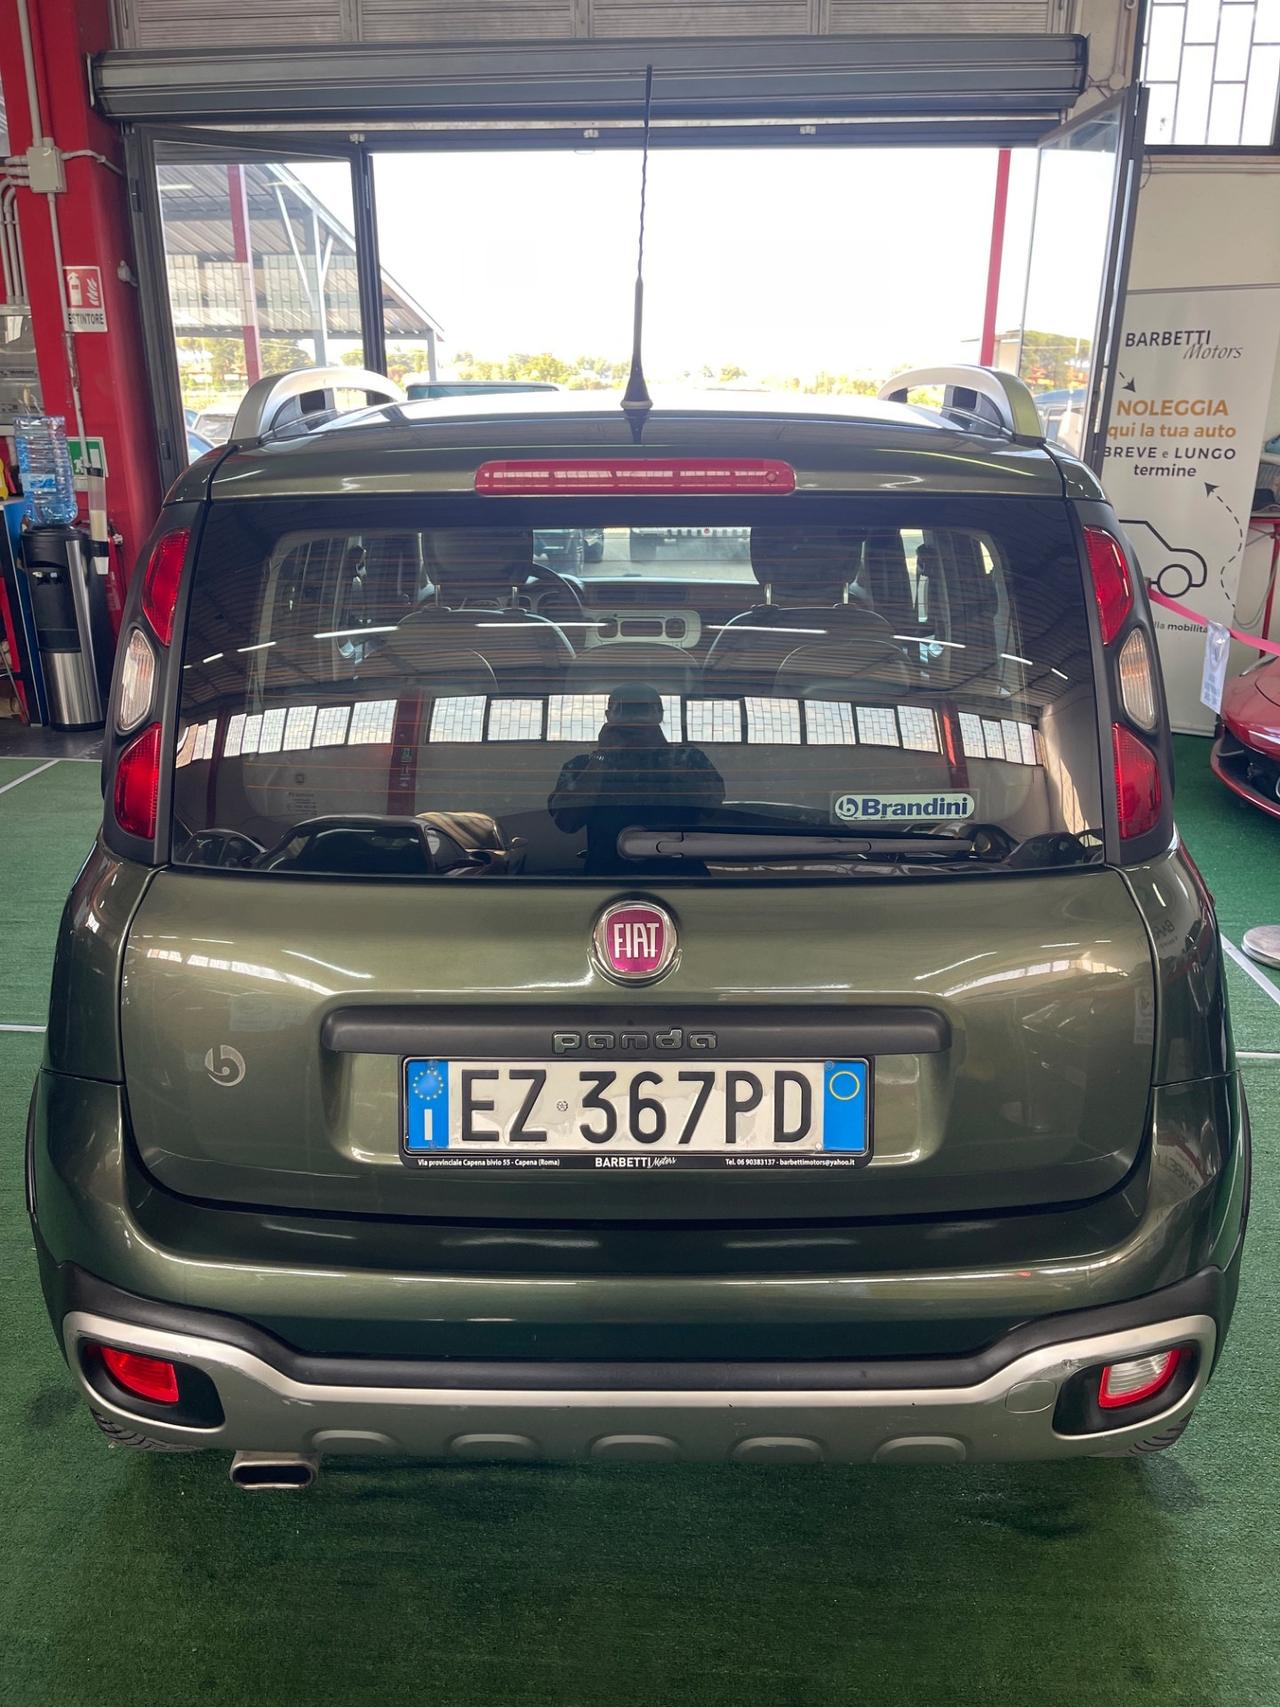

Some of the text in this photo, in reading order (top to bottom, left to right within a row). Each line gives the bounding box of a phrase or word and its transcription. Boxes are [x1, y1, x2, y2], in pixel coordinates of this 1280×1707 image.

[1125, 330, 1211, 347] BARBETTI
[1183, 344, 1244, 360] Motors
[1116, 399, 1229, 416] NOLEGGIA
[1107, 422, 1237, 440] qui la tua auto
[1103, 446, 1236, 460] BREVE e LUNGO
[1134, 464, 1197, 477] termine
[861, 797, 968, 816] Brandini
[613, 922, 660, 959] FIAT
[552, 1028, 718, 1054] panda
[461, 1069, 813, 1144] EZ 367PD
[418, 1159, 428, 1167] Via
[429, 1159, 462, 1167] provinciale
[463, 1159, 486, 1168] Capena
[487, 1159, 502, 1167] bivio
[515, 1159, 538, 1168] Capena
[538, 1159, 560, 1168] (Roma)
[595, 1157, 651, 1168] BARBETTI
[725, 1158, 736, 1166] Tel.
[737, 1158, 745, 1166] 06
[780, 1159, 855, 1167] barbettimotors@yahoo.it
